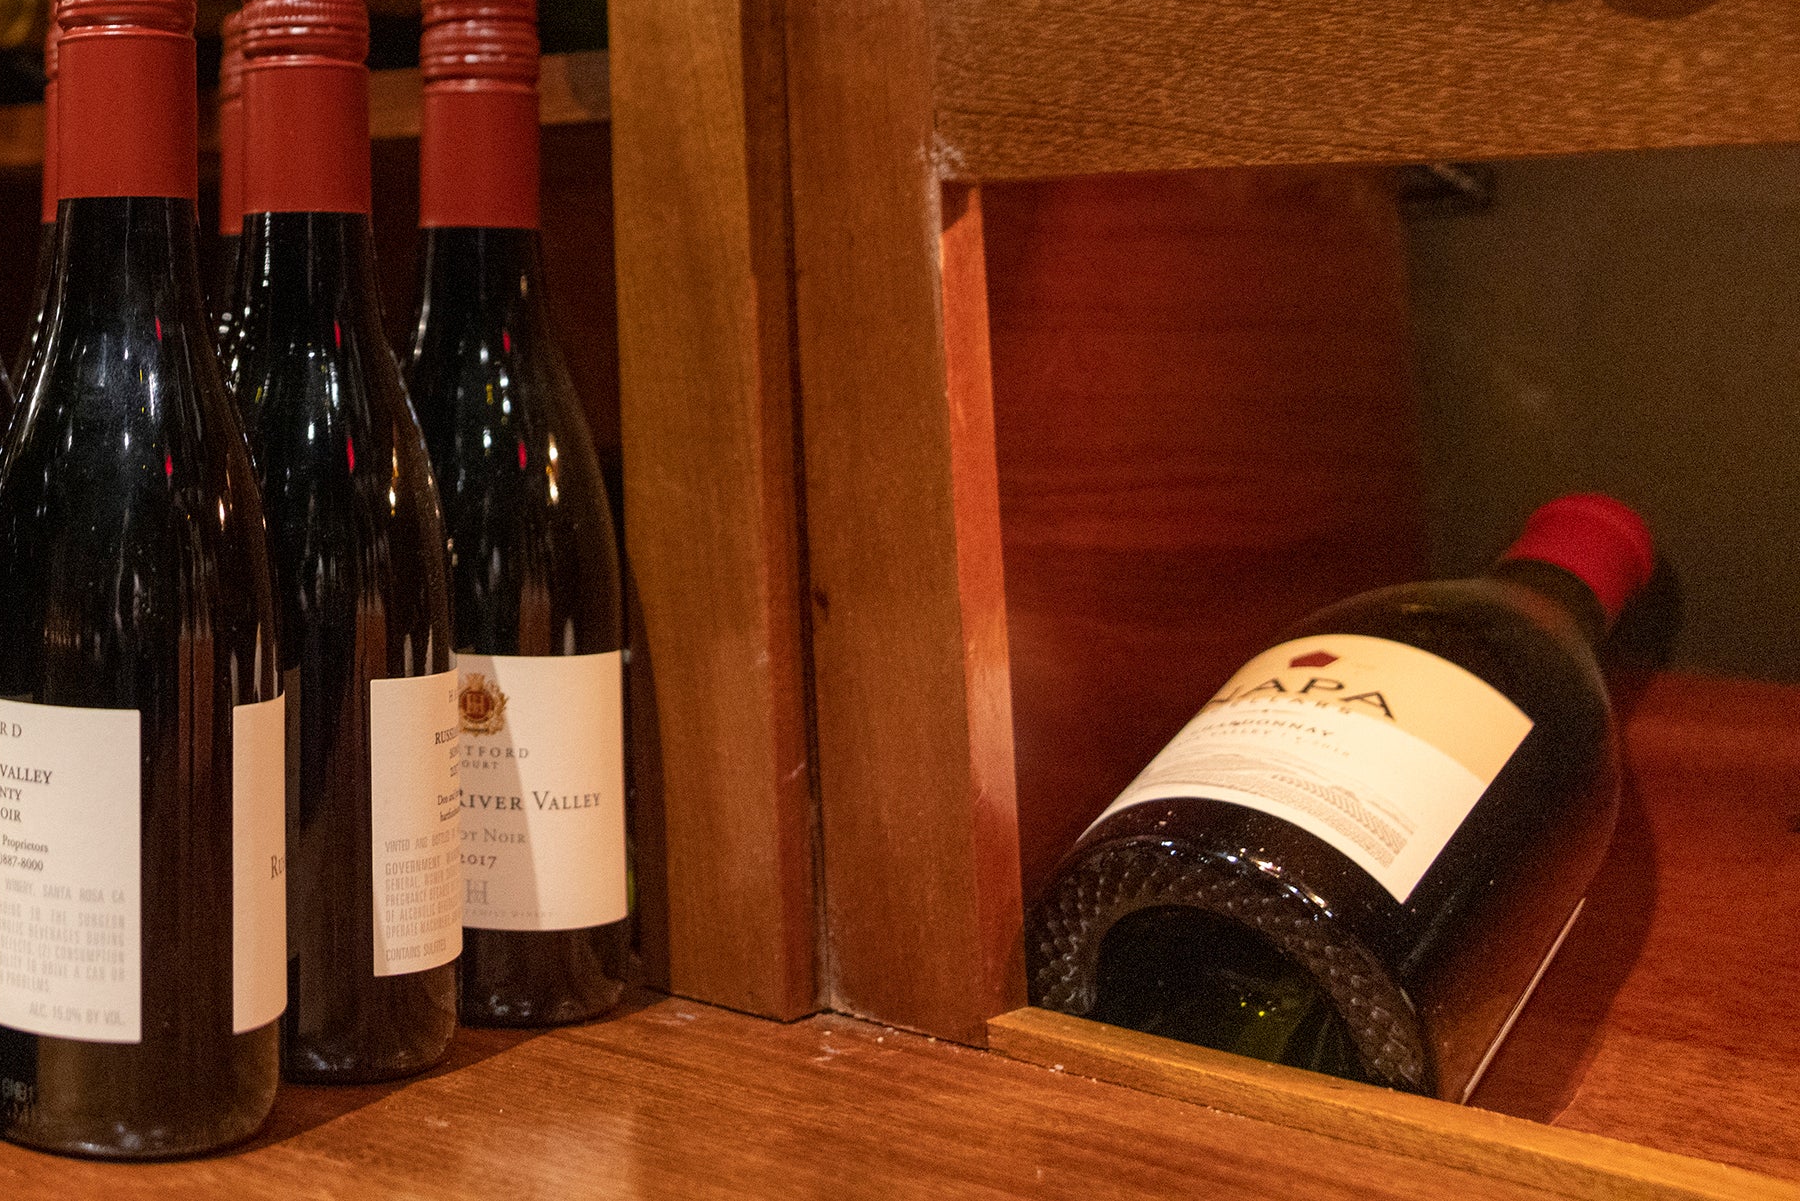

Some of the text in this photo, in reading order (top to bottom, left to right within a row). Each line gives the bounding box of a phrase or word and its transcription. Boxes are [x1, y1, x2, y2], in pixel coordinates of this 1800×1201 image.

[464, 745, 529, 759] TFORD
[461, 759, 499, 770] OURT
[0, 763, 53, 785] VALLEY
[2, 834, 49, 853] Proprietors
[111, 888, 126, 904] CA
